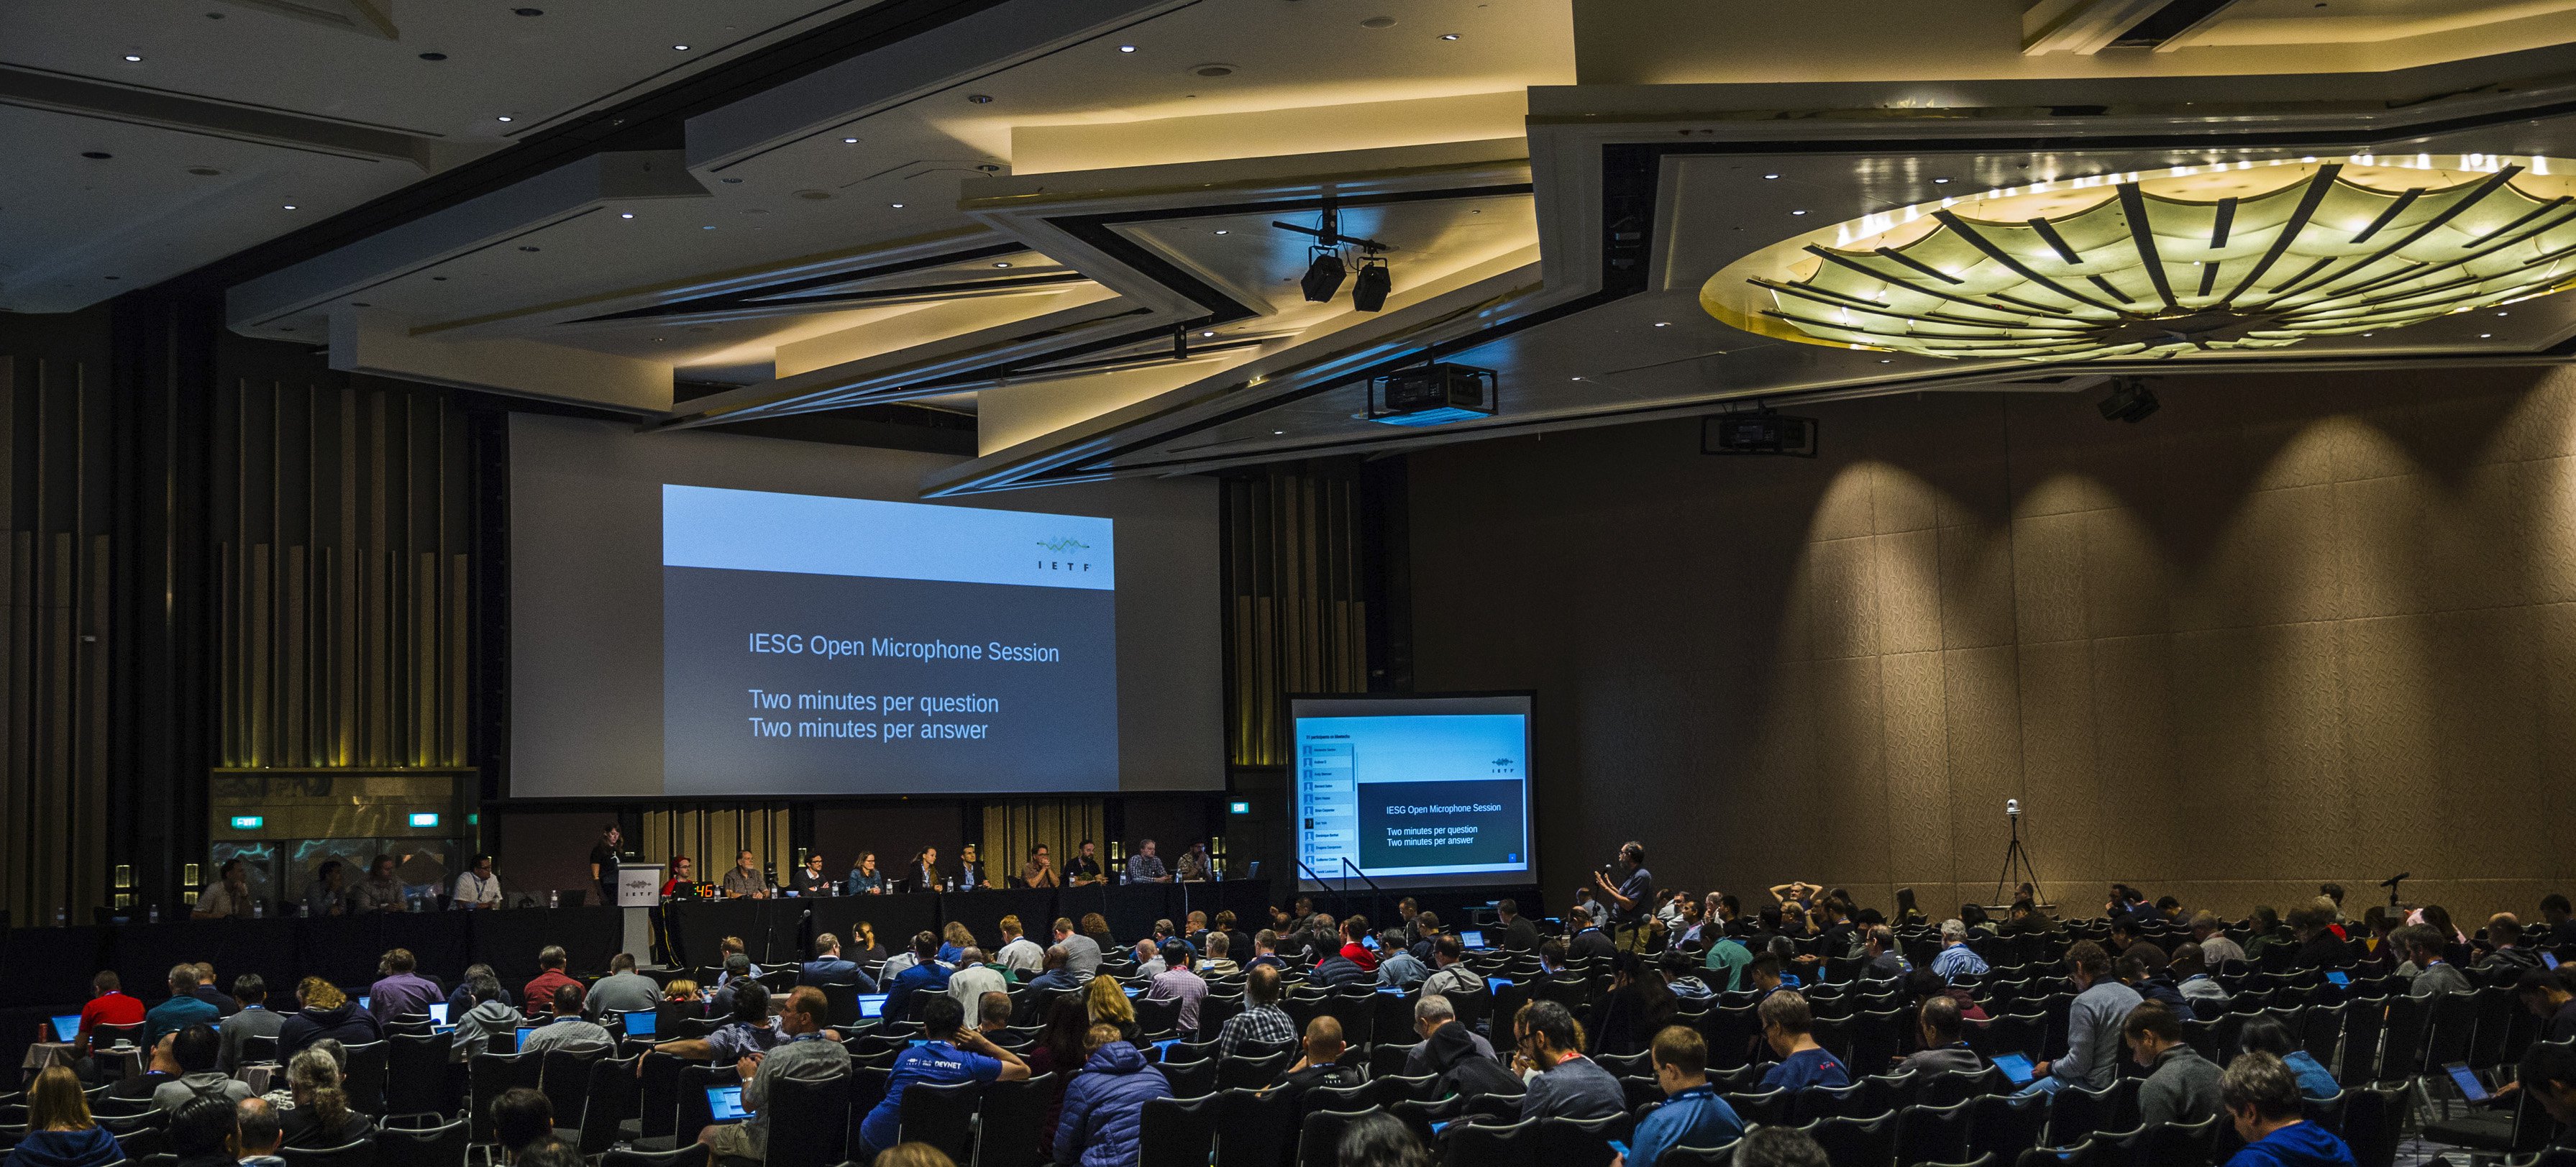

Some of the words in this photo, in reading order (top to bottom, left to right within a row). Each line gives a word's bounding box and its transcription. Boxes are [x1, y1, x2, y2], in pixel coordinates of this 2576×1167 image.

[1038, 561, 1090, 572] IETF
[749, 633, 803, 654] IESG
[810, 635, 864, 660] Open
[872, 637, 982, 662] Microphone
[988, 641, 1059, 662] Session
[749, 690, 792, 710] Two
[798, 690, 877, 711] minutes
[883, 695, 915, 715] per
[921, 694, 999, 715] question
[749, 717, 792, 738] Two
[798, 717, 877, 739] minutes
[883, 723, 915, 743] per
[921, 722, 989, 740] answer
[1387, 806, 1406, 815] IESG
[1407, 805, 1428, 815] Open
[1430, 805, 1471, 815] Microphone
[1473, 803, 1502, 813] Session
[1433, 828, 1446, 836] per
[1447, 825, 1478, 836] question
[1434, 838, 1446, 847] per
[1448, 836, 1474, 845] answer
[935, 1061, 962, 1069] DEVNET
